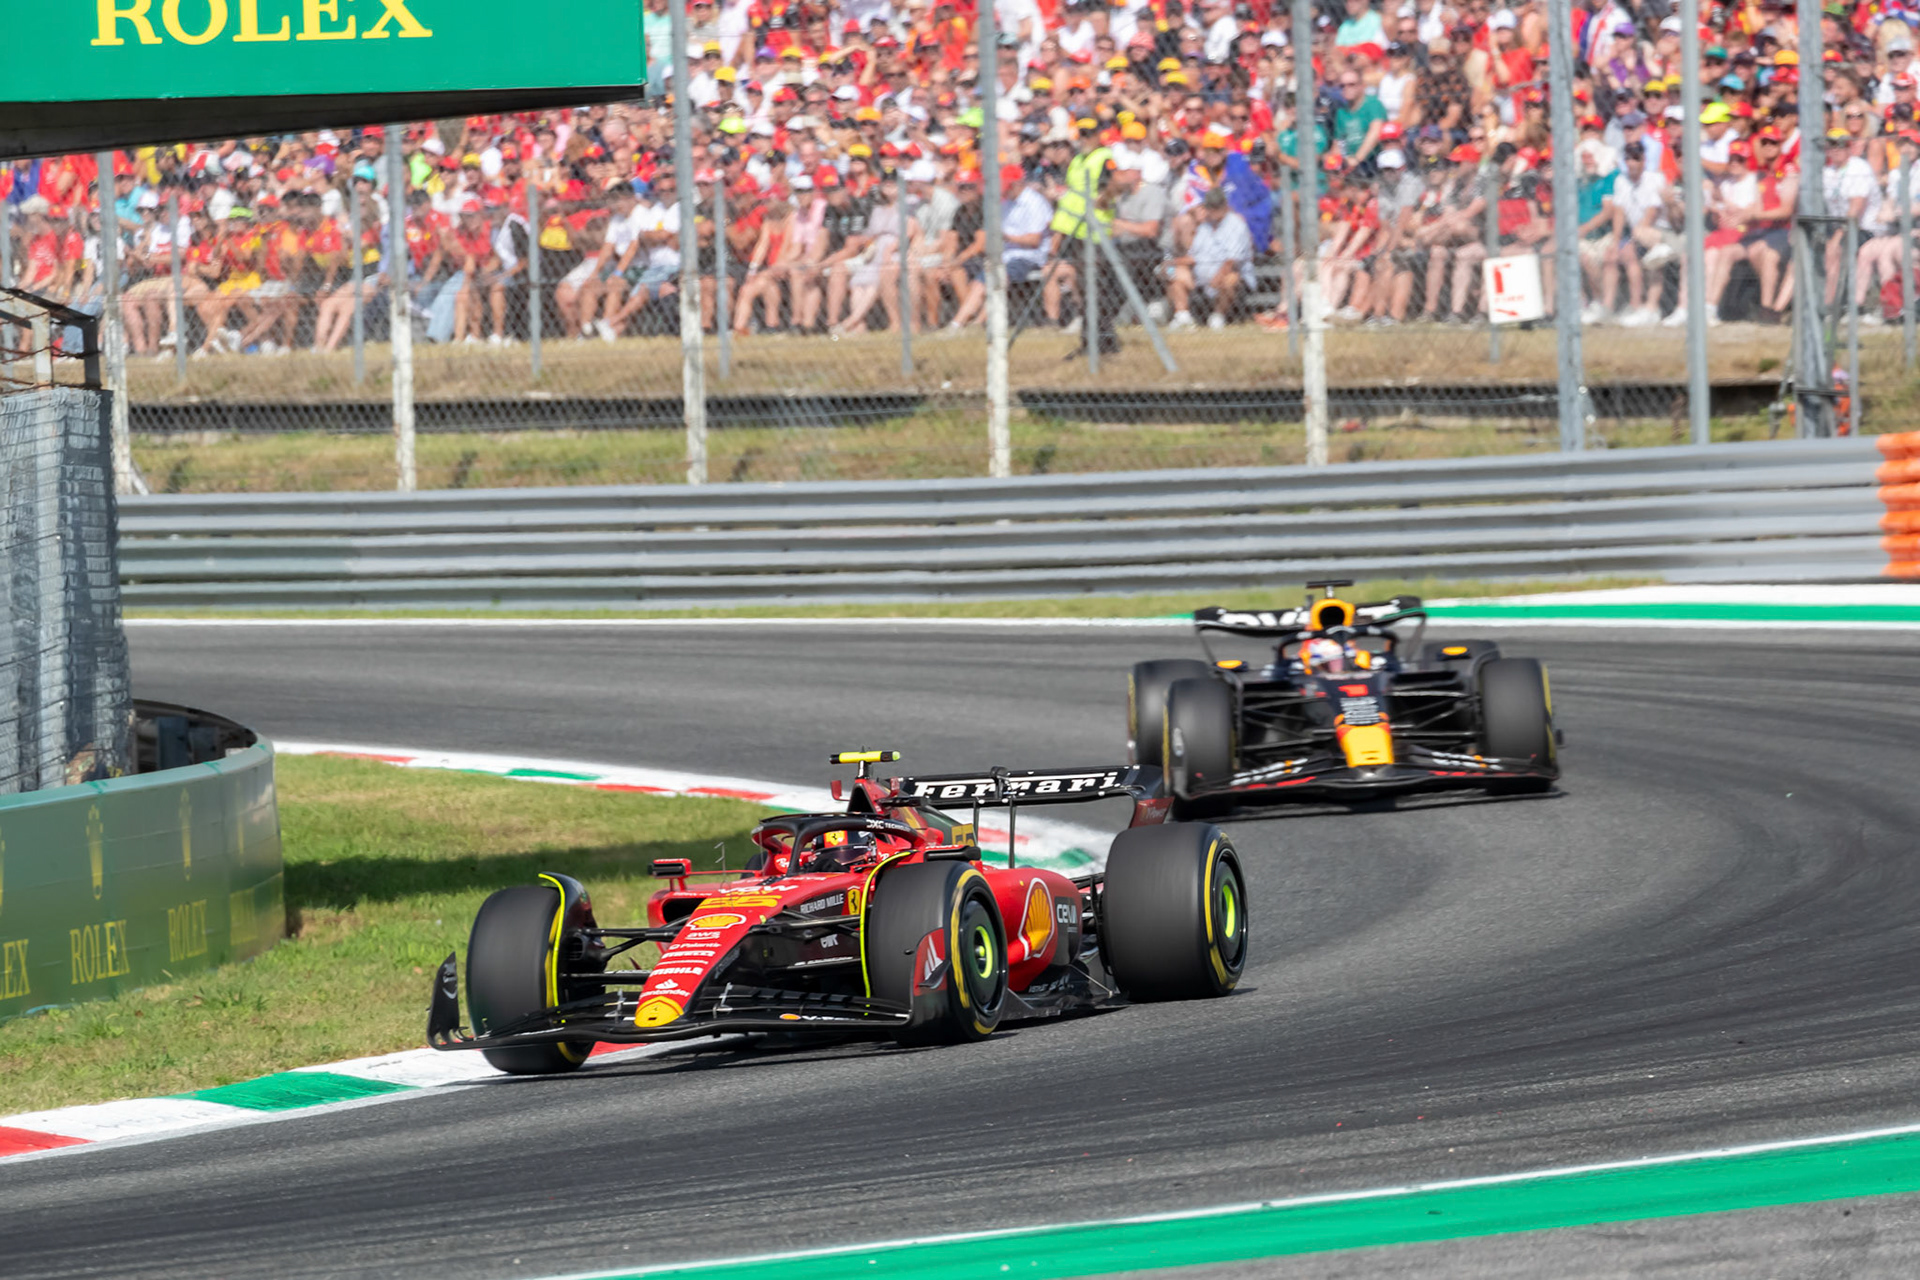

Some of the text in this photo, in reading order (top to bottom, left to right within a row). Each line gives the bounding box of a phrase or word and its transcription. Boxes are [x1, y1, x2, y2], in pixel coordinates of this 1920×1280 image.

[91, 0, 433, 46] ROLEX
[913, 771, 1120, 800] Ferrari
[800, 893, 845, 915] RICHARD MILLE
[69, 919, 131, 985] ROLEX
